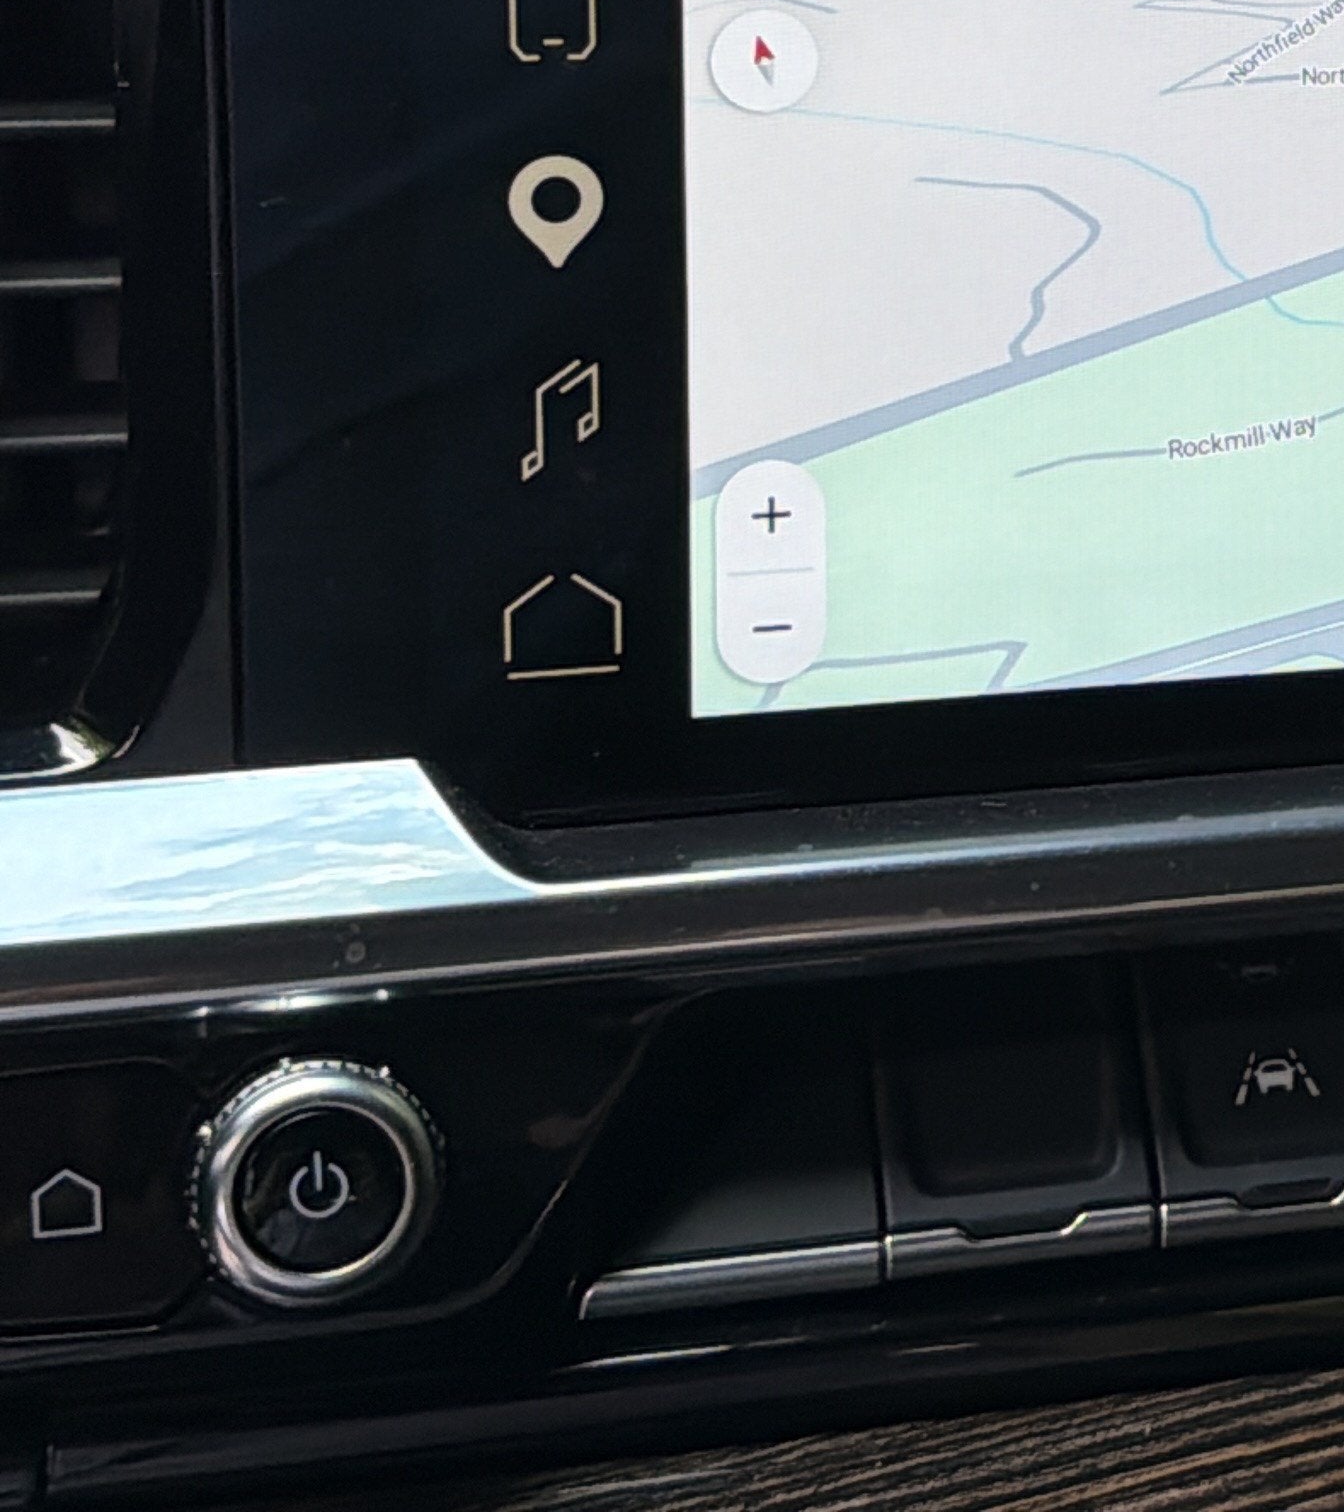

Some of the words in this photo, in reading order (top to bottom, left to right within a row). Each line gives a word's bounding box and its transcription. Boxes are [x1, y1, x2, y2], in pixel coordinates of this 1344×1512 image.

[1228, 13, 1317, 85] Northfield
[1167, 425, 1267, 459] Rockmill
[1268, 414, 1318, 449] Way
